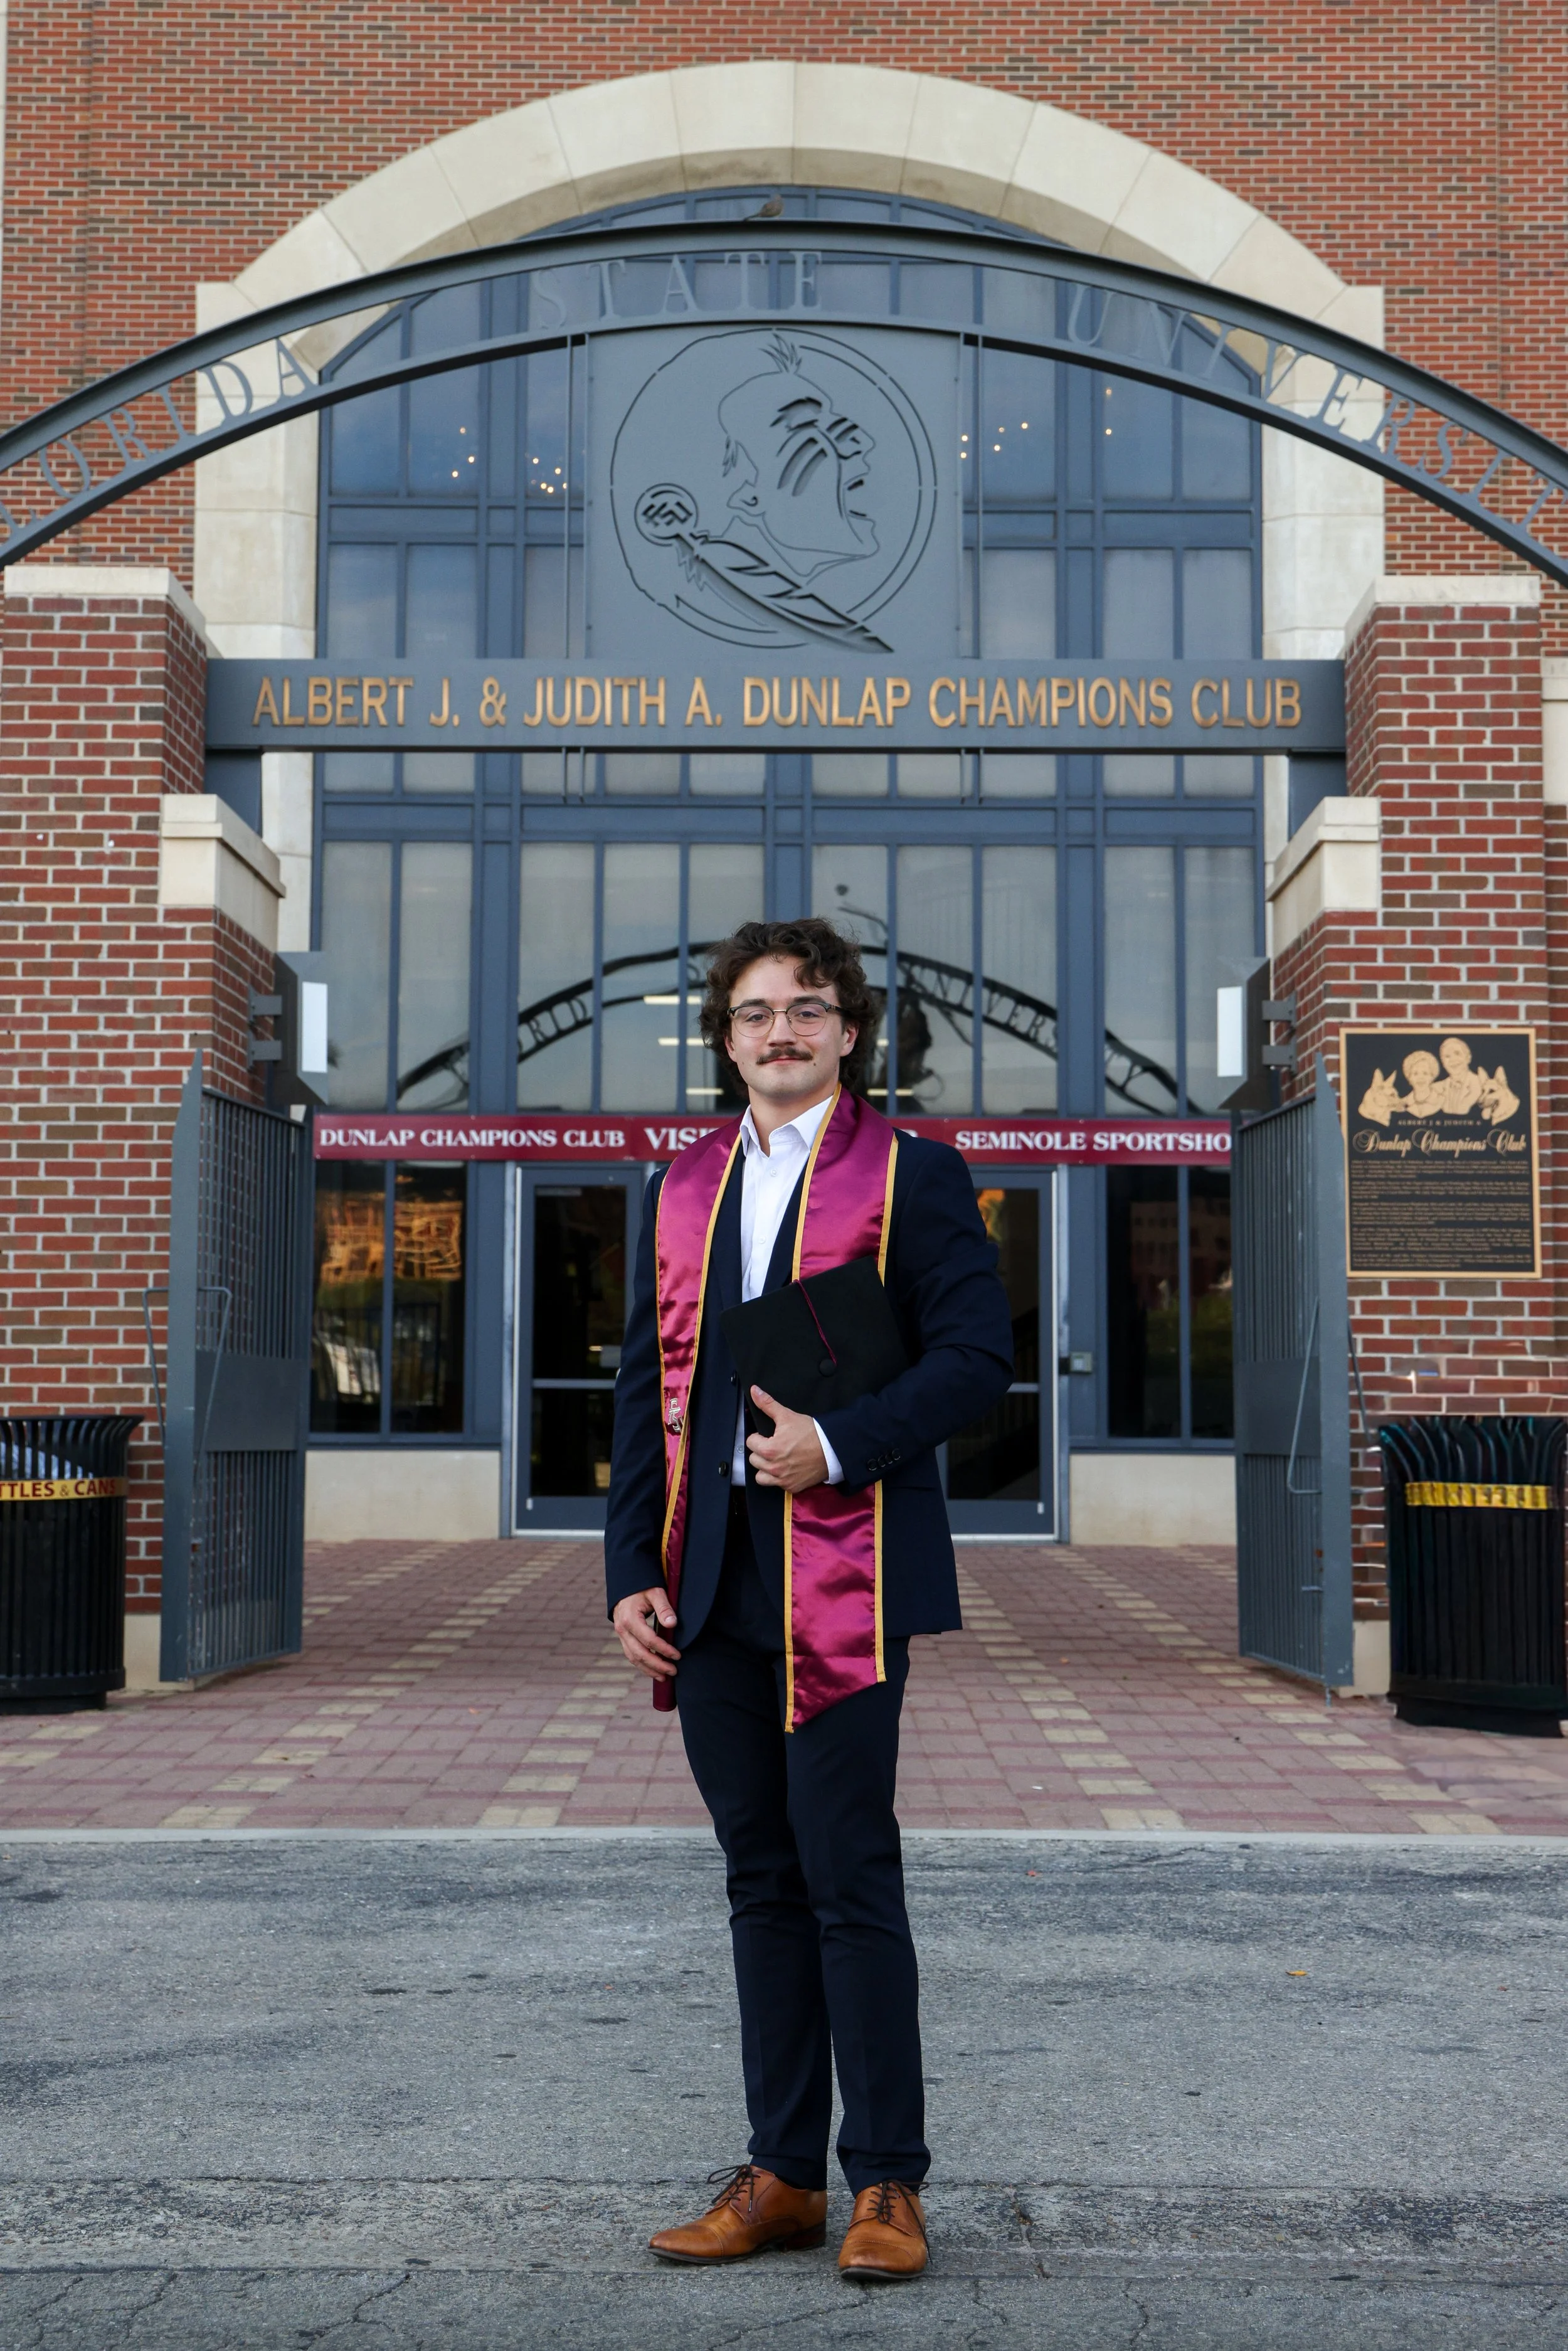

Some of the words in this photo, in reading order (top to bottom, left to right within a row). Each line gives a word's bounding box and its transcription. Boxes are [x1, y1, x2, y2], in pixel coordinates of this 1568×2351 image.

[532, 252, 823, 329] STATE
[253, 676, 414, 727] ALBERT
[429, 676, 460, 727] J.
[479, 676, 506, 726] &
[523, 676, 666, 727] JUDITH
[685, 676, 723, 727] A.
[743, 677, 911, 727] DUNLAP
[929, 677, 1173, 728] CHAMPIONS
[1191, 678, 1302, 728] CLUB
[320, 1130, 414, 1147] DUNLAP
[420, 1130, 558, 1148] CHAMPIONS
[563, 1130, 625, 1148] CLUB
[955, 1130, 1087, 1151] SEMINOLE
[1093, 1131, 1232, 1152] SPORTSHO
[1352, 1129, 1411, 1158] Dunlap
[1412, 1128, 1486, 1158] Champions
[1487, 1128, 1526, 1157] Club
[60, 1483, 69, 1497] &
[74, 1479, 115, 1496] CANS
